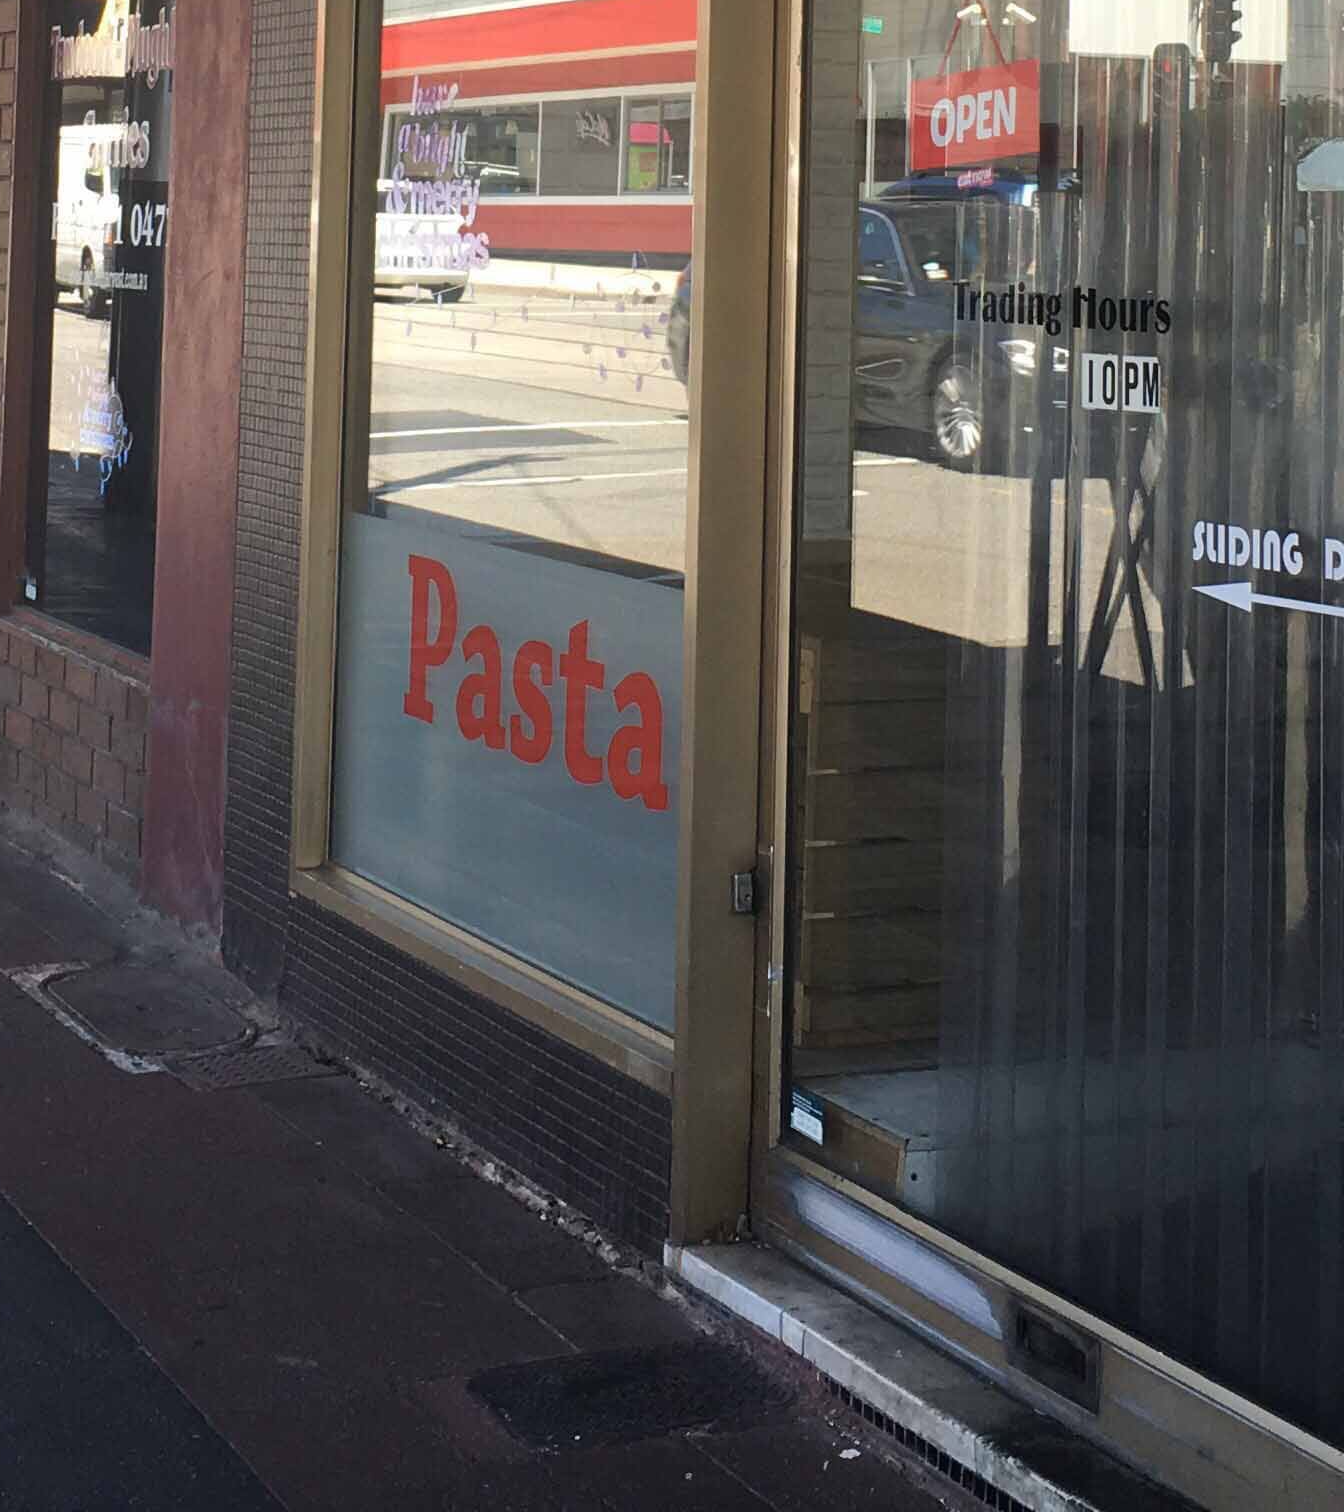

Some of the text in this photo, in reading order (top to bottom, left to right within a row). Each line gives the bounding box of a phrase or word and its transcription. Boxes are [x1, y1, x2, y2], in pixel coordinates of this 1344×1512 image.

[929, 85, 1017, 148] OPEN
[953, 282, 1171, 336] Trading Hours
[1191, 519, 1304, 575] SLIDING
[403, 553, 669, 812] Pasta
